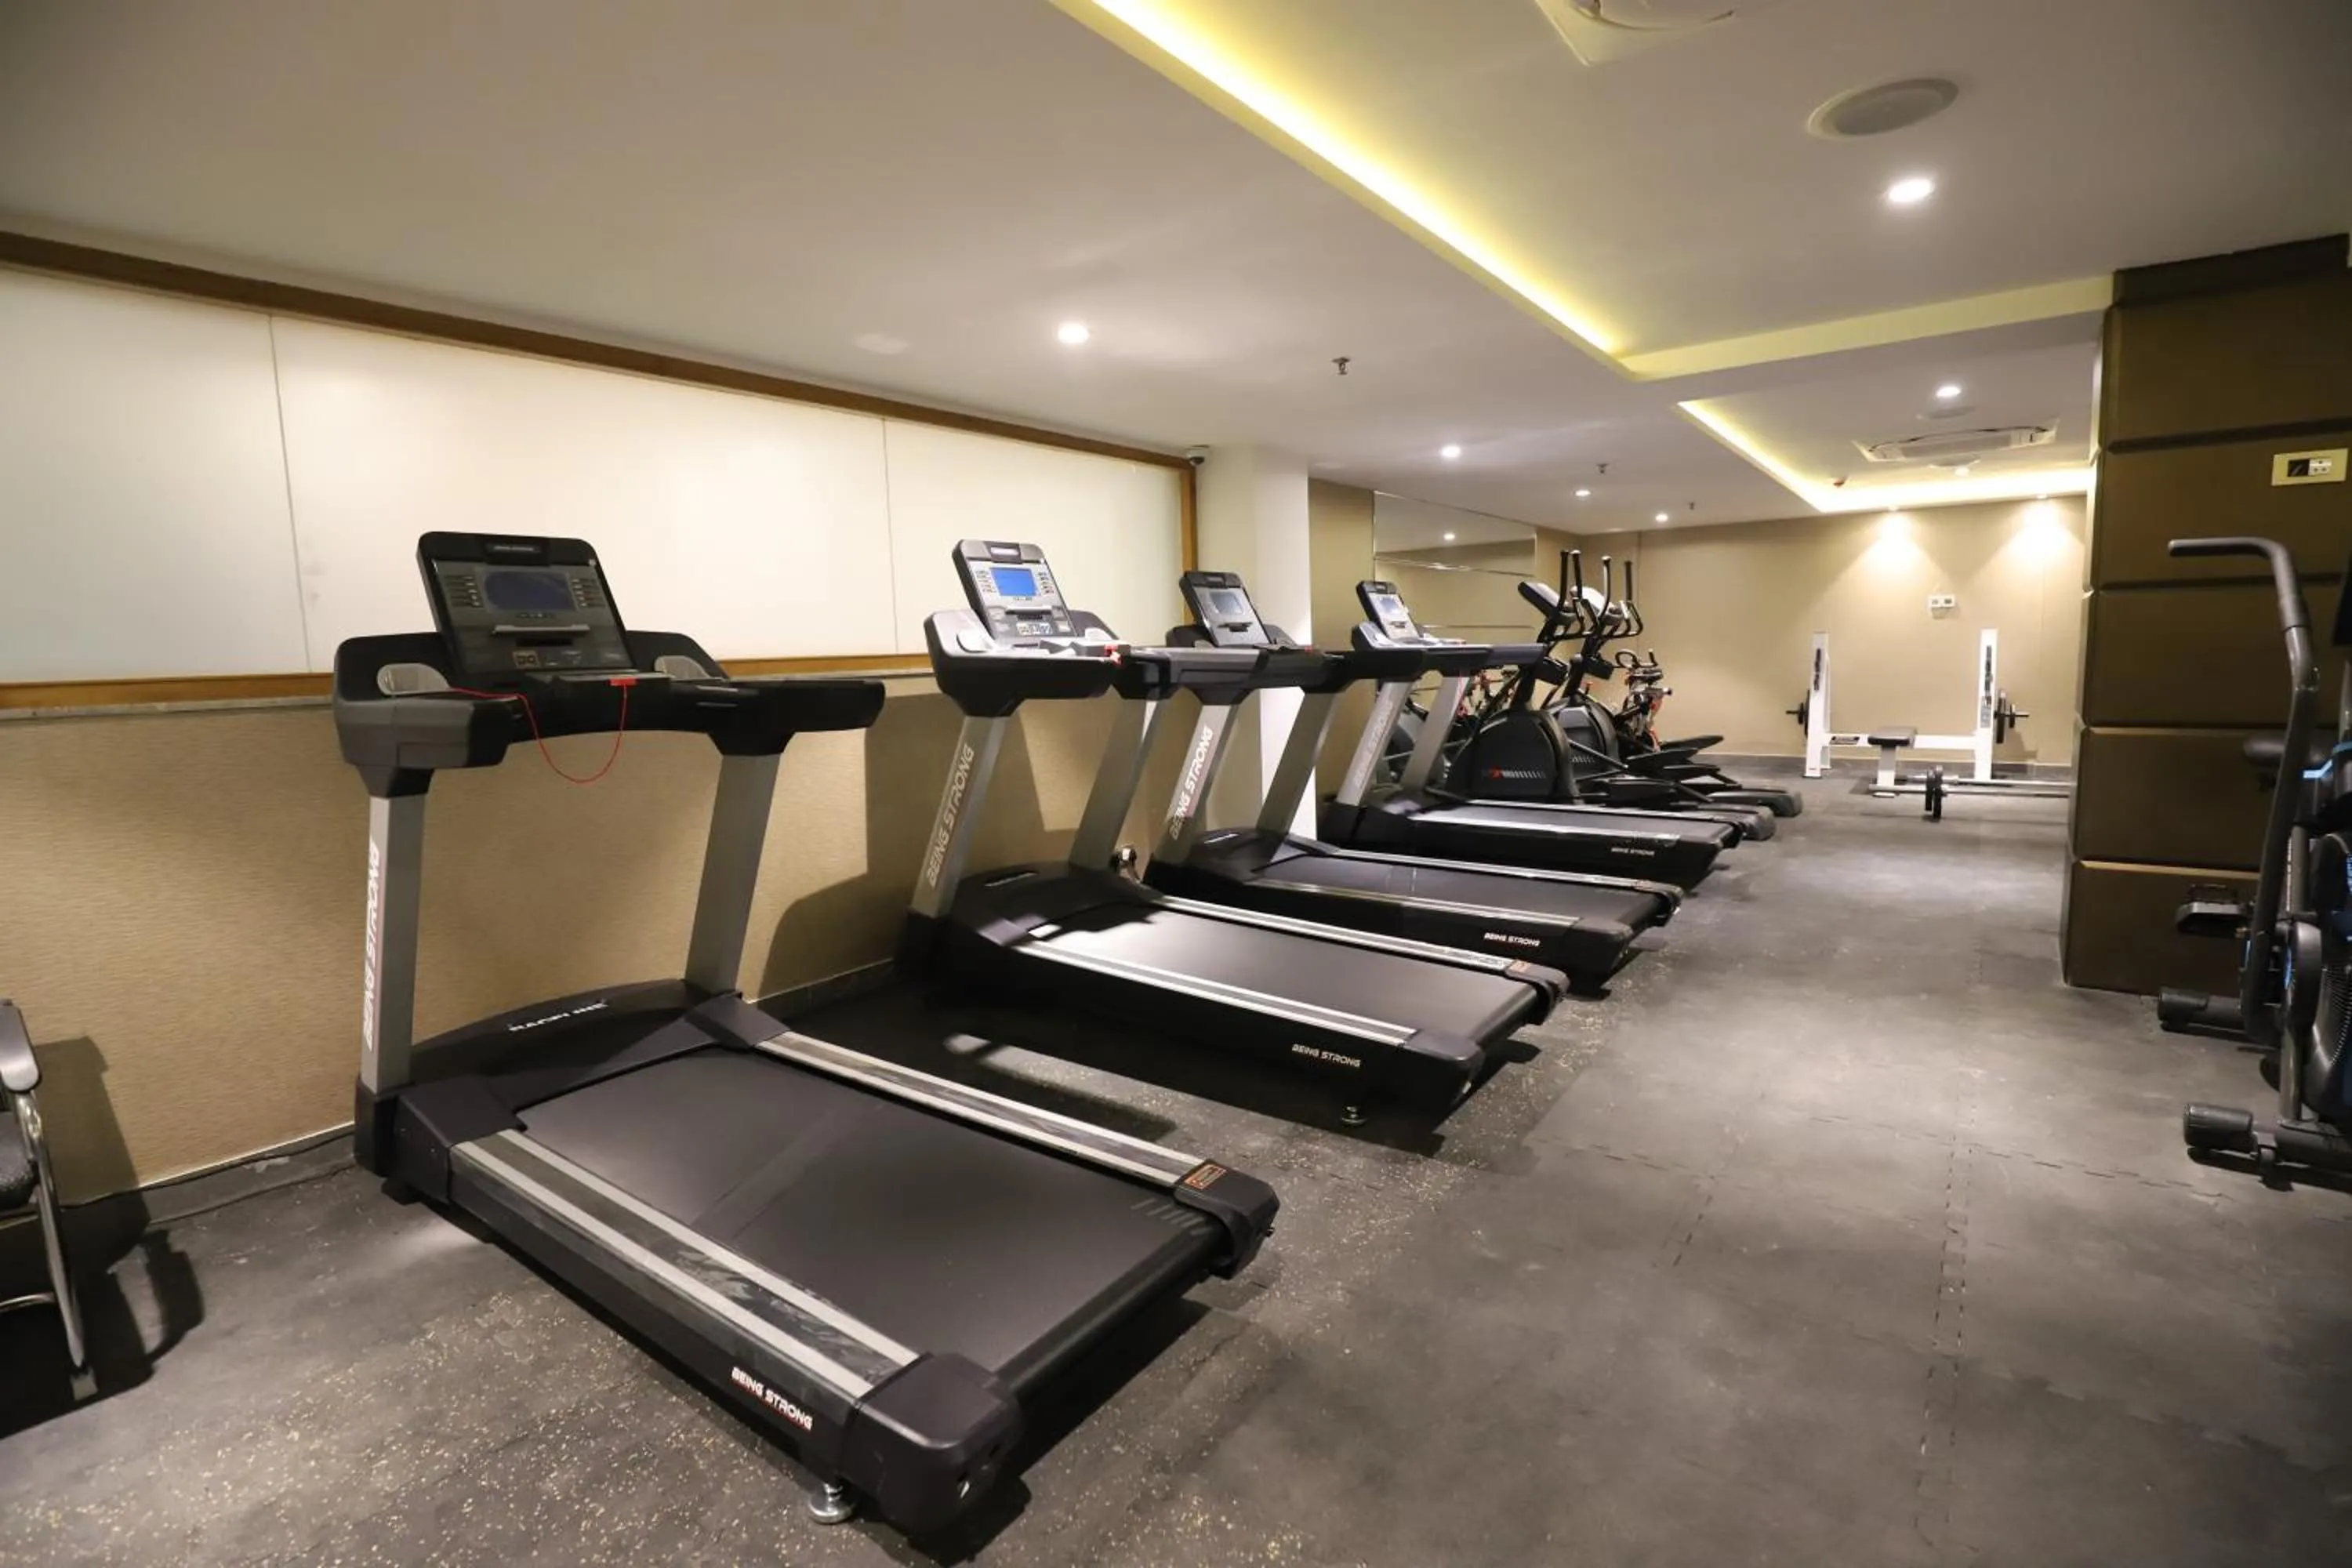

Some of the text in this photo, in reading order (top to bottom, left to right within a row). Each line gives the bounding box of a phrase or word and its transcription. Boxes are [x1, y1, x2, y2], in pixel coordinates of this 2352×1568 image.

[1185, 724, 1212, 794] STRONG
[927, 743, 975, 887] BEING STRONG
[364, 837, 380, 1052] BEING STRONG
[1291, 1044, 1361, 1067] BEING STRONG
[731, 1367, 813, 1431] BEING STRONG
